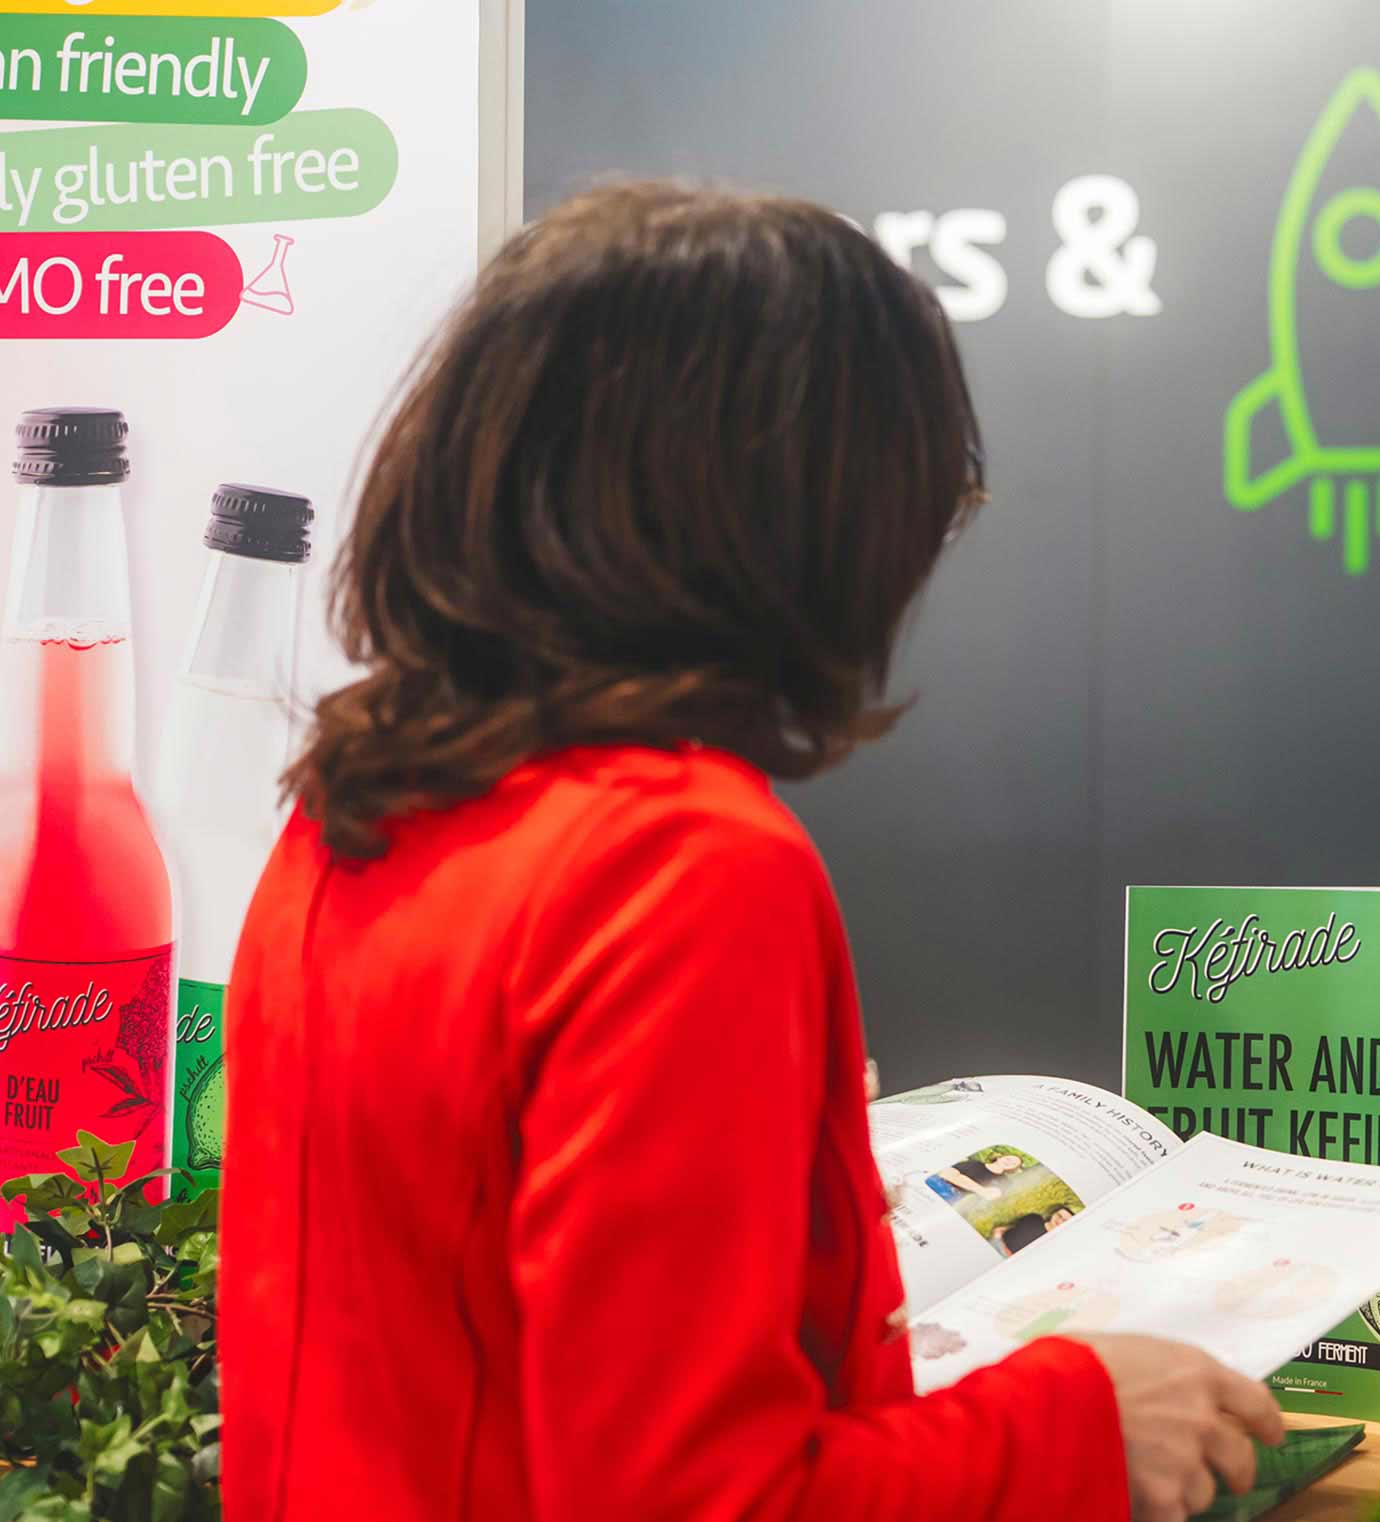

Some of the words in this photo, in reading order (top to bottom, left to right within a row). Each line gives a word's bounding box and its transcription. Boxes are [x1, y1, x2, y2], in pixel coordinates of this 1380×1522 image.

[0, 49, 41, 91] n
[56, 31, 270, 116] friendly
[53, 145, 232, 224] gluten
[248, 134, 359, 195] free
[860, 208, 1008, 322] rs
[1046, 174, 1163, 318] &
[95, 253, 205, 315] free
[1149, 912, 1361, 1004] Kéfirade
[0, 980, 112, 1051] éfirade
[7, 1075, 61, 1104] D'EAU
[1145, 1031, 1293, 1091] WATER
[5, 1102, 55, 1131] FRUIT
[1106, 1109, 1168, 1158] HISTORY
[1243, 1161, 1294, 1175] WHAT
[1296, 1170, 1311, 1179] IS
[1316, 1171, 1377, 1187] WATER
[1272, 1375, 1293, 1385] Made
[1294, 1376, 1302, 1385] in
[1303, 1377, 1328, 1387] France
[1318, 1342, 1368, 1364] FERMENT
